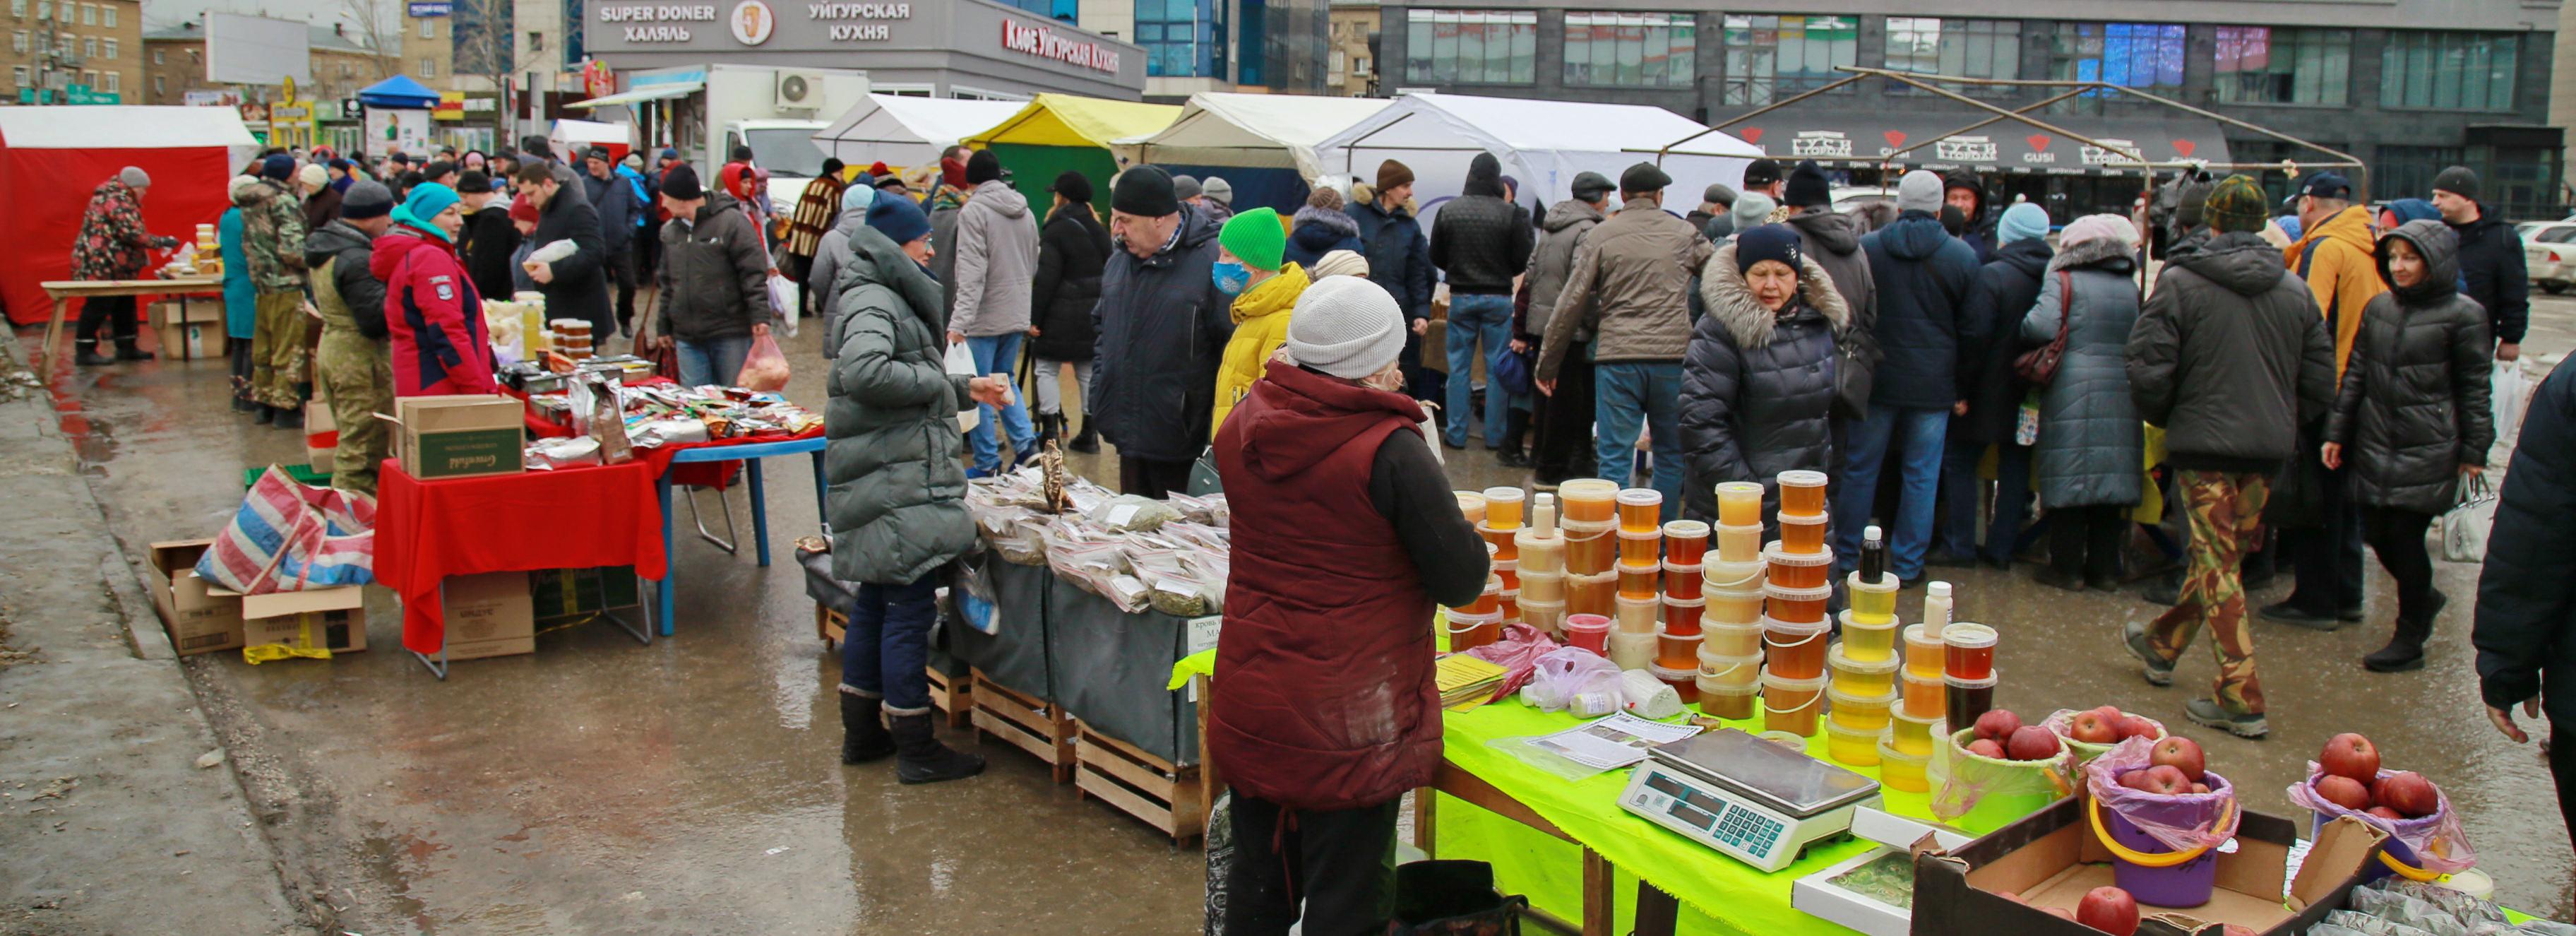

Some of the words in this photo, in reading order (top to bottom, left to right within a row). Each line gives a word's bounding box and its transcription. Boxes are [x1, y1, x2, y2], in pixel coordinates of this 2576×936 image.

[600, 6, 655, 22] SUPER
[657, 6, 715, 21] DONER
[809, 1, 910, 19] УЙГУРСКАЯ
[624, 26, 691, 42] ХАЛЯЛЬ
[830, 25, 890, 41] КУХНЯ
[1005, 18, 1037, 53] КАФЕ
[1039, 26, 1091, 67] УЙГУРСКАЯ
[1091, 42, 1119, 73] КУХНЯ
[2023, 152, 2055, 162] GUSI
